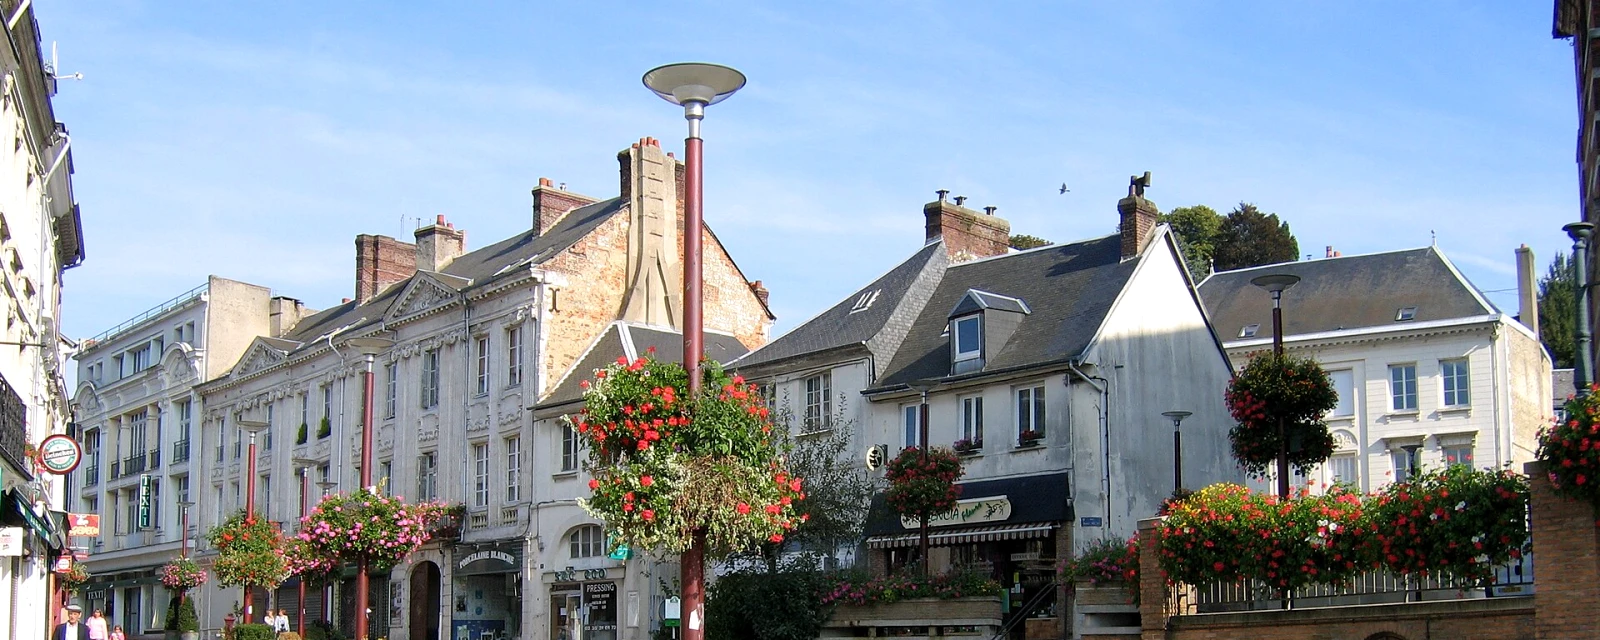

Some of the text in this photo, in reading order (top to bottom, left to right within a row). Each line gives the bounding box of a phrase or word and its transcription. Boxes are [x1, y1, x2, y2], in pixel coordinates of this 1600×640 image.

[141, 476, 150, 526] TEXTI
[459, 550, 515, 569] PORCELAINE BLANCHE
[586, 583, 615, 592] PRESSING
[87, 590, 104, 600] TEXTI
